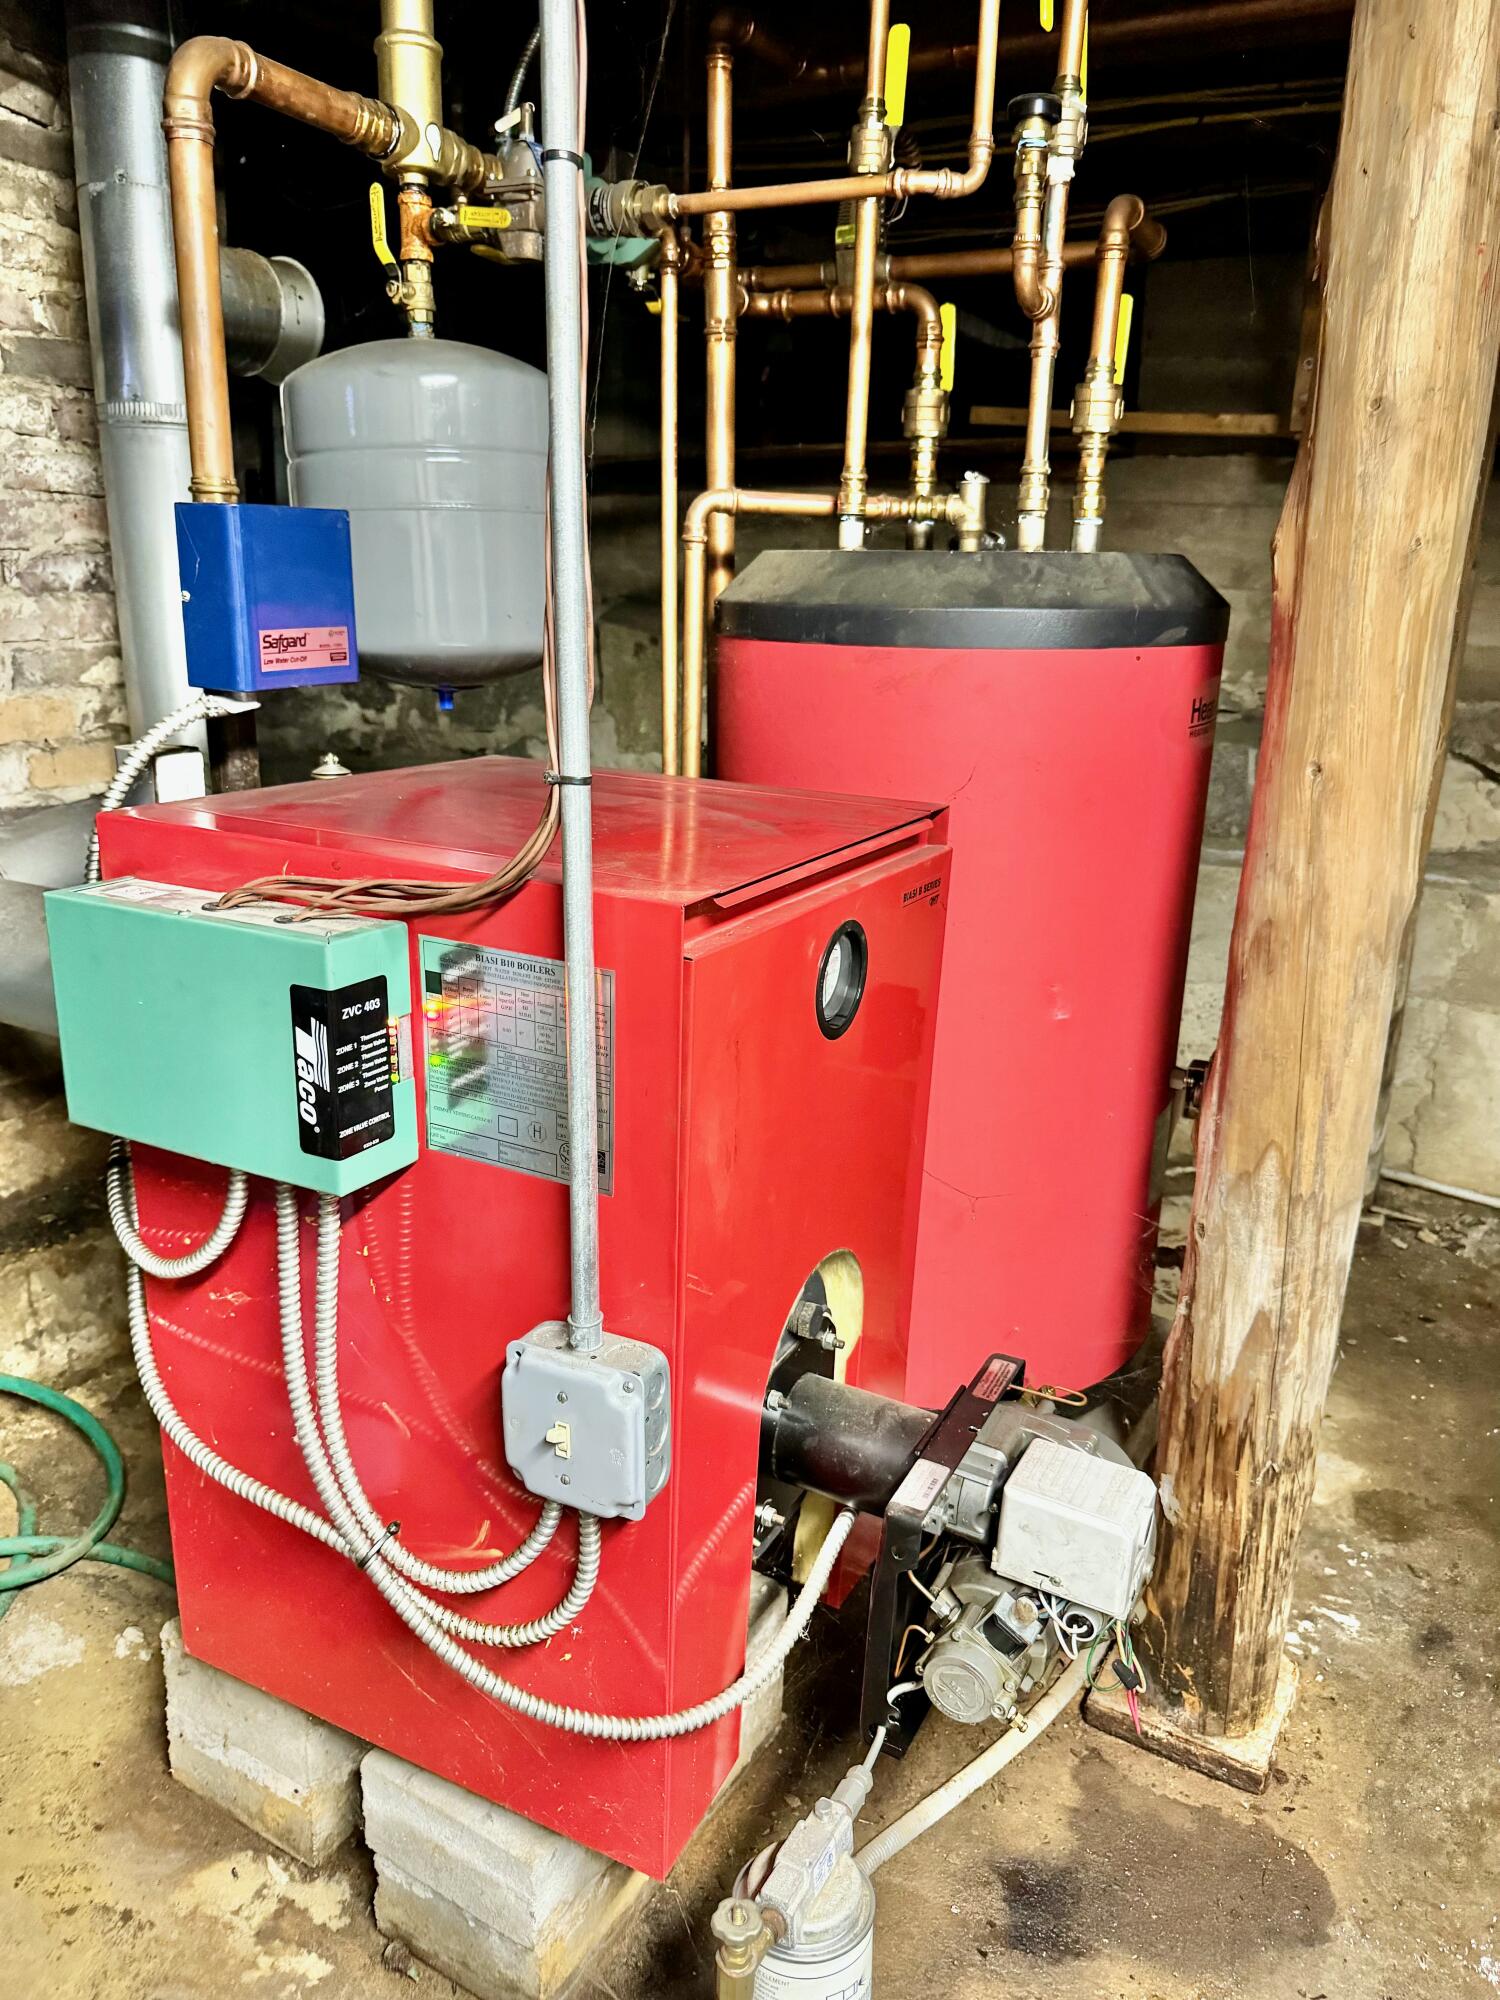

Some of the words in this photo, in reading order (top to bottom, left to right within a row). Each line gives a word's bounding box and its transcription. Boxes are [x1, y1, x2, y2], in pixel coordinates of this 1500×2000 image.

[262, 632, 307, 653] Safgard
[923, 877, 941, 893] SERIES
[475, 953, 498, 965] BIASI
[500, 958, 515, 969] B10
[517, 962, 556, 976] BOILERS
[341, 1003, 363, 1020] ZVC
[363, 997, 381, 1012] 403
[335, 1043, 354, 1055] ZONE
[353, 1041, 358, 1049] 1
[336, 1062, 355, 1074] ZONE
[354, 1060, 359, 1068] 2
[337, 1081, 356, 1093] ZONE
[355, 1079, 360, 1087] 3
[338, 1126, 354, 1139] ZONE
[353, 1120, 369, 1132] VALVE
[368, 1111, 391, 1126] CONTROL
